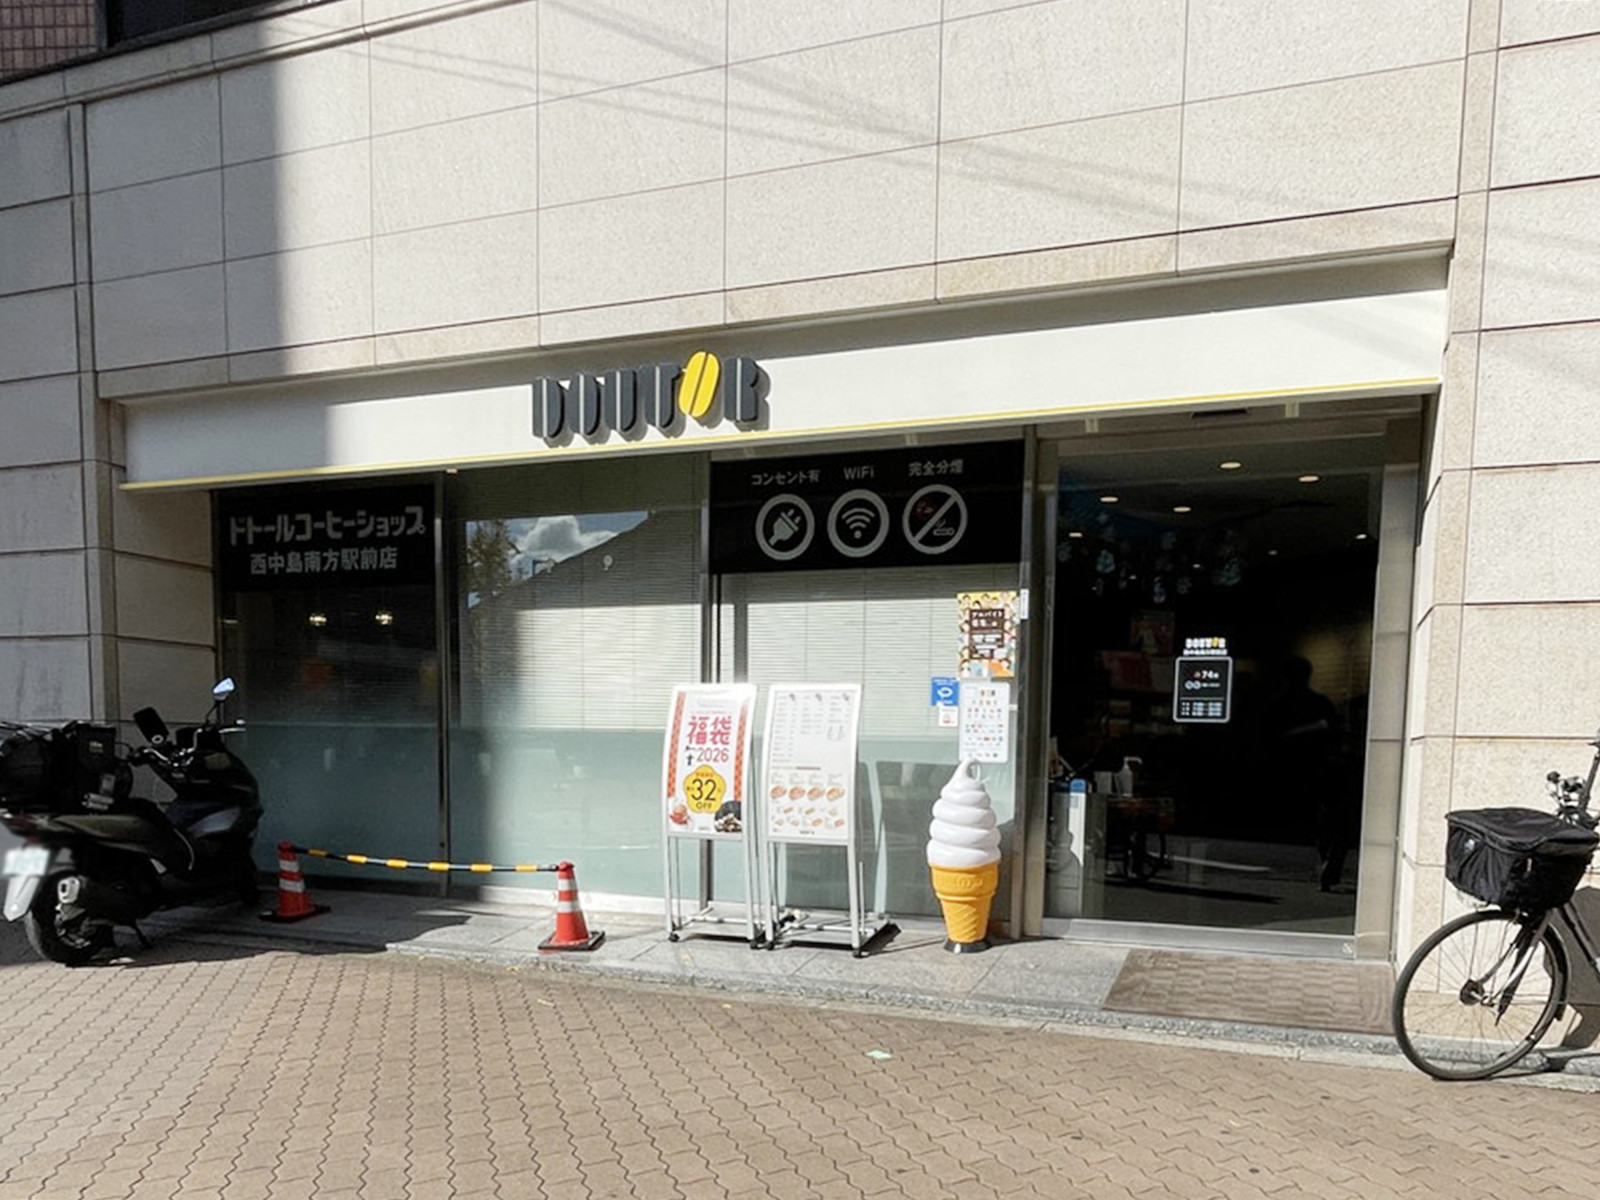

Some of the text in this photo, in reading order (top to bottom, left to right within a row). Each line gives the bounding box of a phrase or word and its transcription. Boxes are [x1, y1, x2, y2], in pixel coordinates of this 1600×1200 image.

[531, 351, 760, 439] DOUTOR
[751, 469, 821, 486] コンセント有
[843, 465, 875, 481] WiFi
[230, 506, 426, 546] ドトールコーヒーショップ
[250, 546, 398, 575] 西中島南方駅前店
[687, 716, 732, 745] 福袋
[696, 747, 730, 763] 2026
[691, 778, 717, 801] 32
